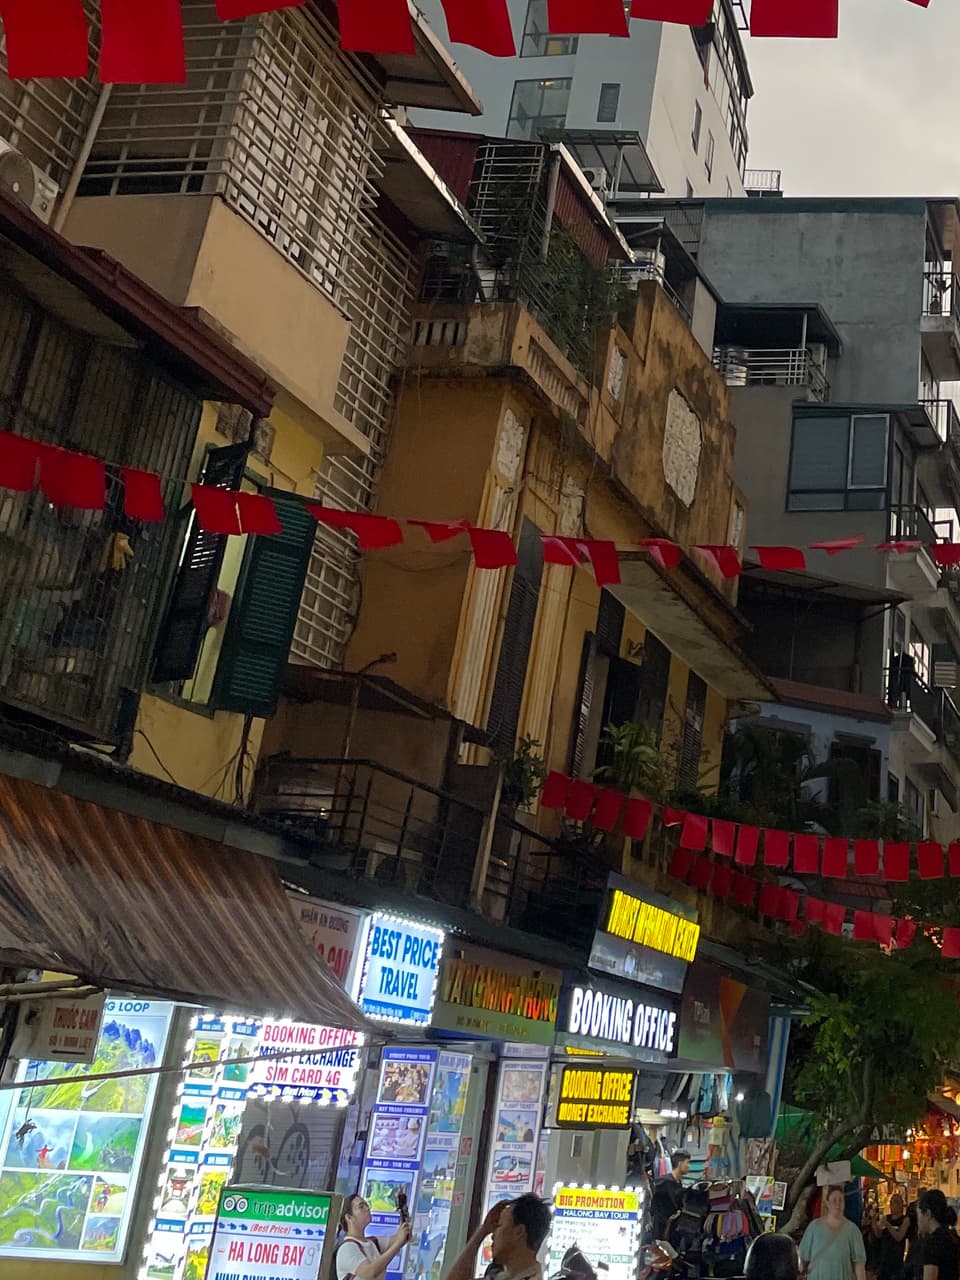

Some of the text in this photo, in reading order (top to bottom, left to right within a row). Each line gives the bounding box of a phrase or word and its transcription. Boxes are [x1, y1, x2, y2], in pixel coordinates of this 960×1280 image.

[371, 926, 439, 970] BEST PRICE
[379, 966, 419, 1000] TRAVEL
[119, 1002, 150, 1013] LOOP
[569, 987, 633, 1043] BOOKING
[633, 1004, 677, 1052] OFFICE
[263, 1025, 316, 1045] BOOKING
[319, 1028, 358, 1047] OFFICE
[298, 1047, 357, 1068] EXCHANGE
[265, 1066, 341, 1085] SIM CARD 4G
[561, 1070, 633, 1101] BOOKING OFFICE
[558, 1103, 630, 1125] MONEY EXCHANGE
[253, 1200, 328, 1219] tripadvisor
[559, 1195, 625, 1209] BIG PROMOTION
[250, 1223, 291, 1234] (Best Price)
[228, 1241, 305, 1266] HA LONG BAY
